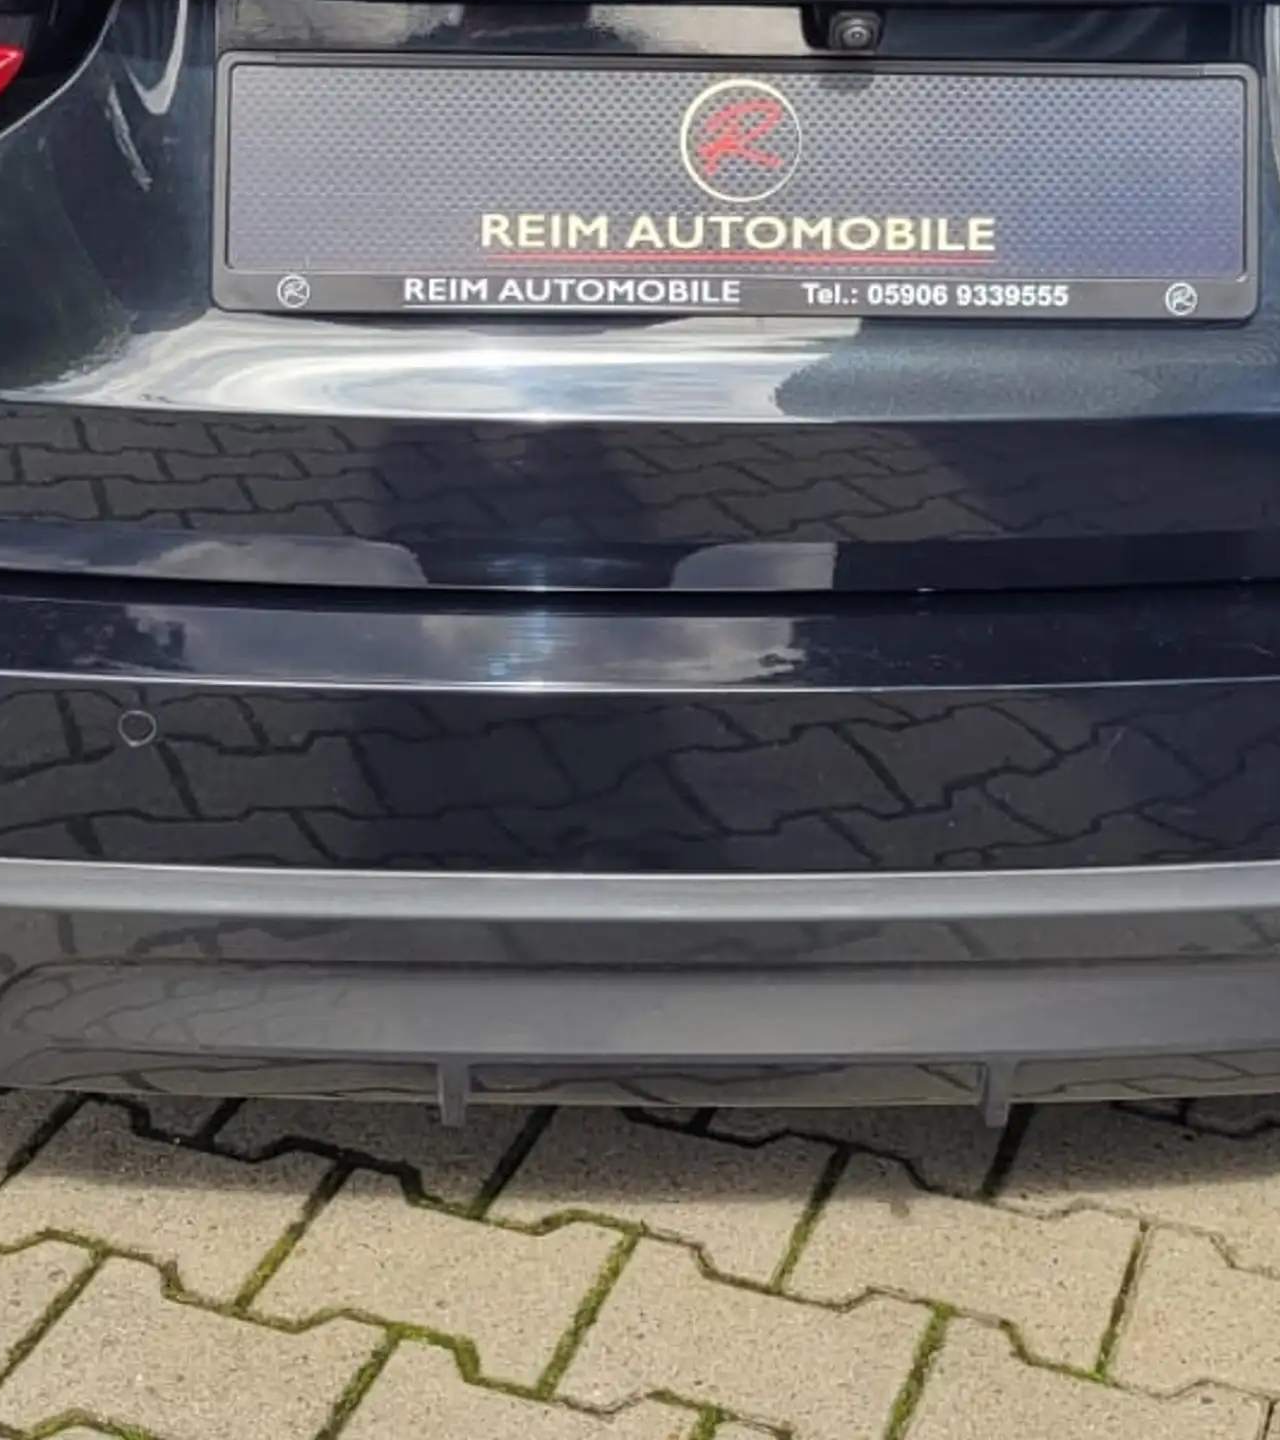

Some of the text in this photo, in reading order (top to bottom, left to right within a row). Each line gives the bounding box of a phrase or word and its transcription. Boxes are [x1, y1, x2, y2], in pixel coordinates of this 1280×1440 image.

[481, 214, 996, 251] REIM AUTOMOBILE
[404, 278, 740, 303] REIM AUTOMOBILE
[802, 283, 1069, 306] Tel.: 05906 9339555
